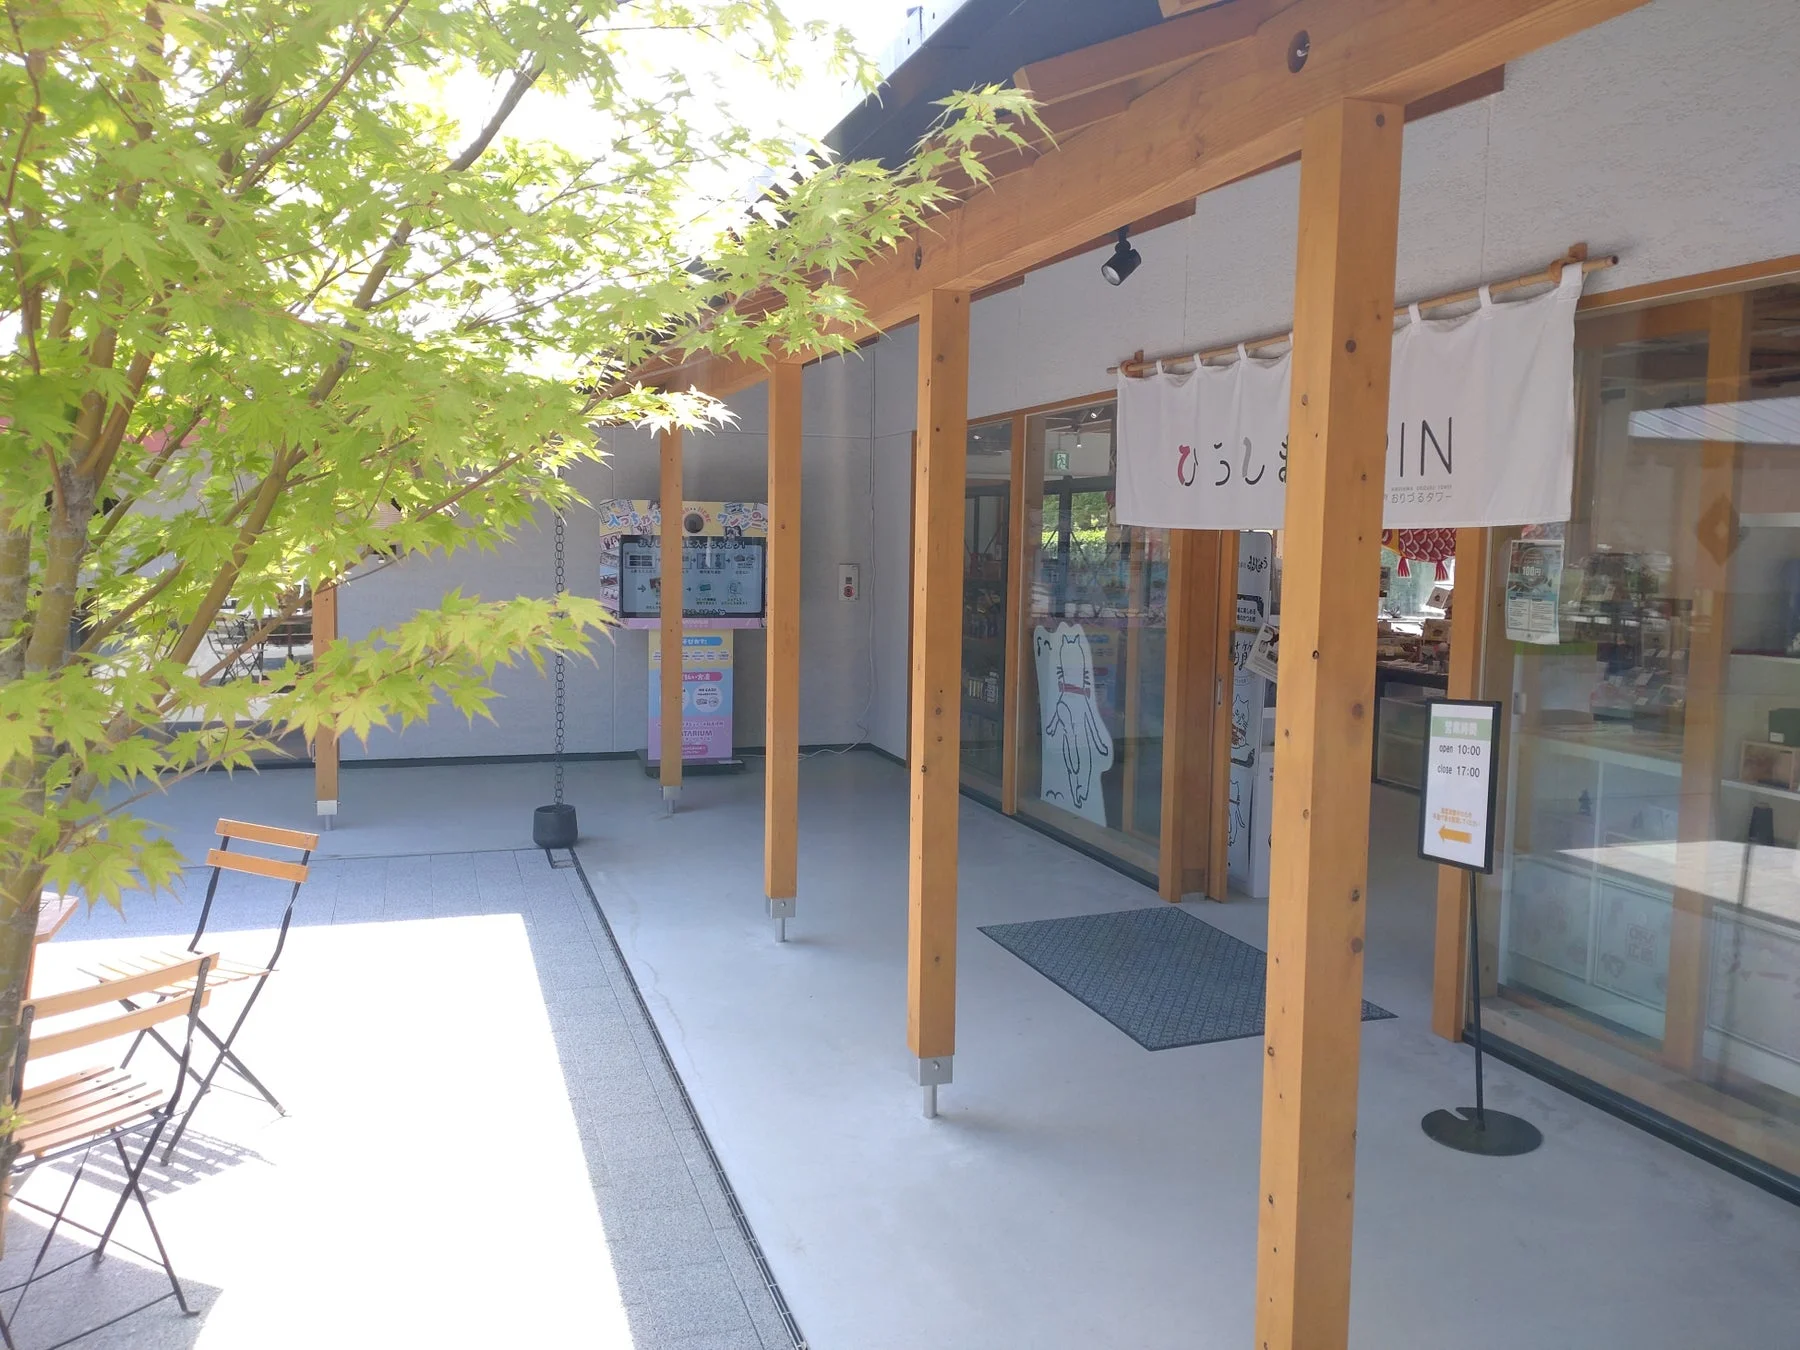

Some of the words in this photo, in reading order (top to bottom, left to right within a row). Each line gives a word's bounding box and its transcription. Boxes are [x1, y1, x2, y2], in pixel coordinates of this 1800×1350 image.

[1386, 417, 1453, 478] IN
[1391, 491, 1452, 504] おりづるタワー
[1438, 744, 1454, 754] open
[1458, 744, 1481, 756] 10:00
[1437, 763, 1453, 775] close
[1456, 765, 1480, 778] 17:00
